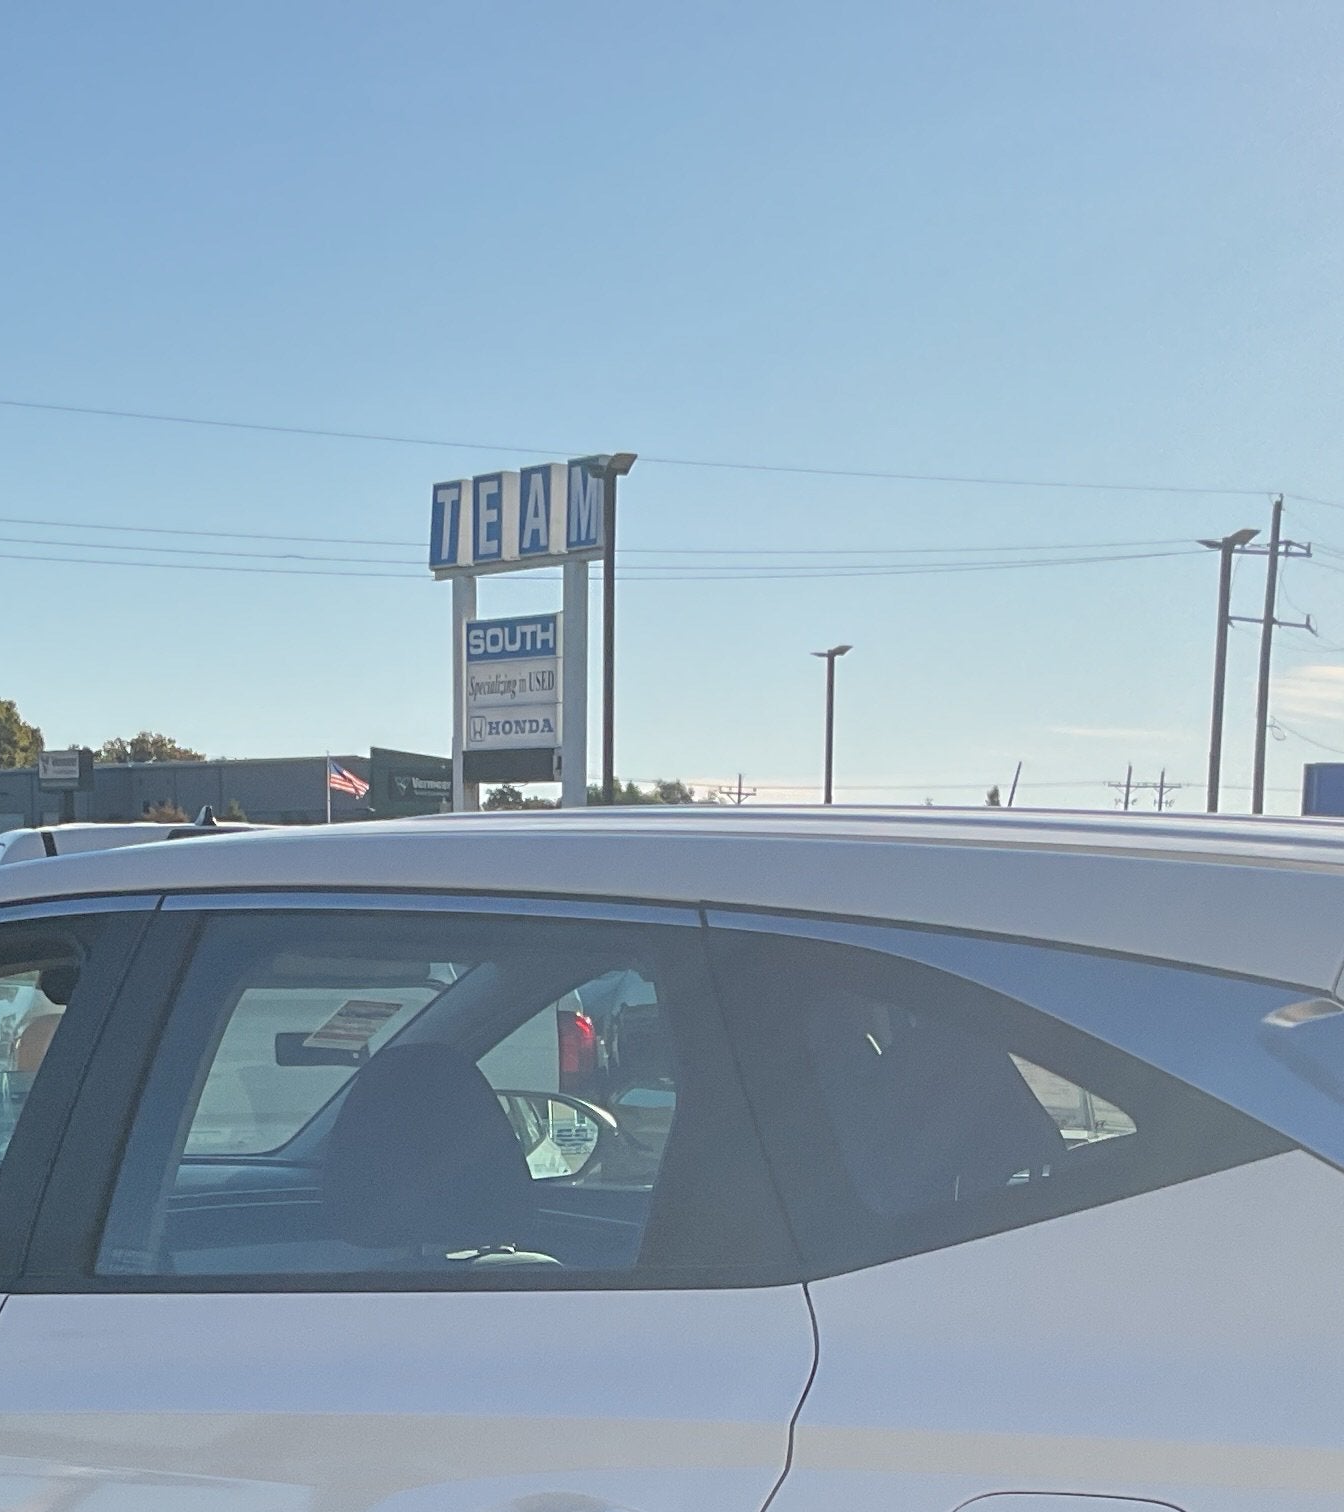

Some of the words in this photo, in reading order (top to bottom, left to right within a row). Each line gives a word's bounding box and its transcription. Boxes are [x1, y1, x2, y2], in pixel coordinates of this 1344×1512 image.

[437, 466, 598, 561] TEAM
[469, 623, 554, 655] SOUTH
[469, 674, 516, 701] Specializing
[518, 674, 527, 693] in
[529, 670, 554, 692] USED
[488, 718, 554, 736] HONDA
